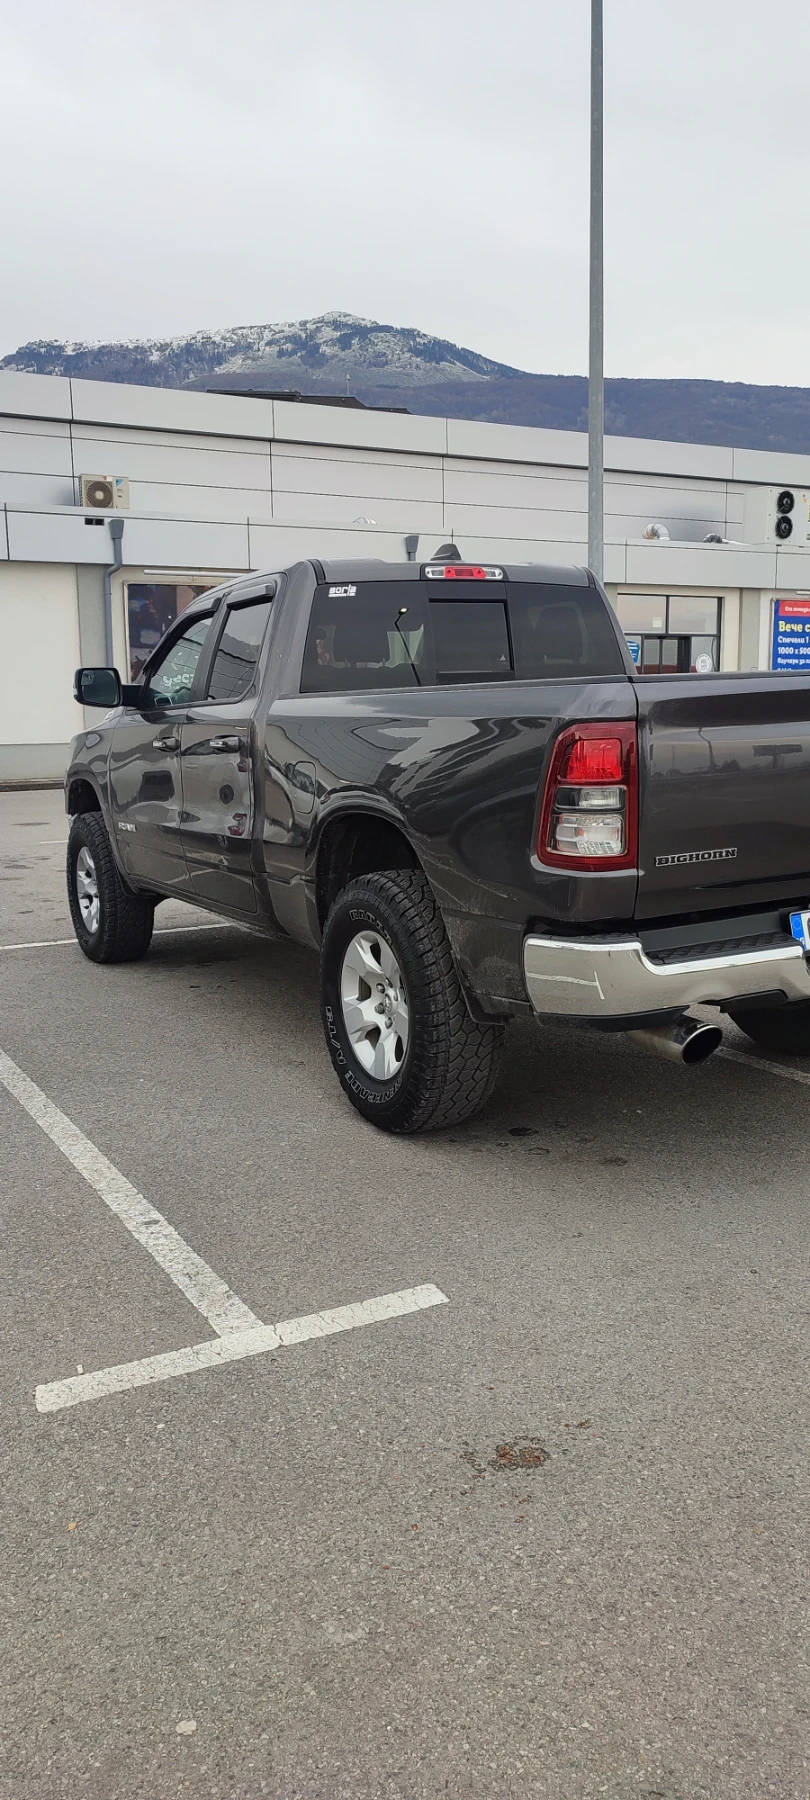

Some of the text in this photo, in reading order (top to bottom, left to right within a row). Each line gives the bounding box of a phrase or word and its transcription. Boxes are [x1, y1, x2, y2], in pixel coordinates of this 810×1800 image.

[778, 620, 803, 632] Вече
[777, 635, 805, 644] Спечели
[777, 646, 794, 655] 1000
[655, 848, 738, 867] BIGHORN
